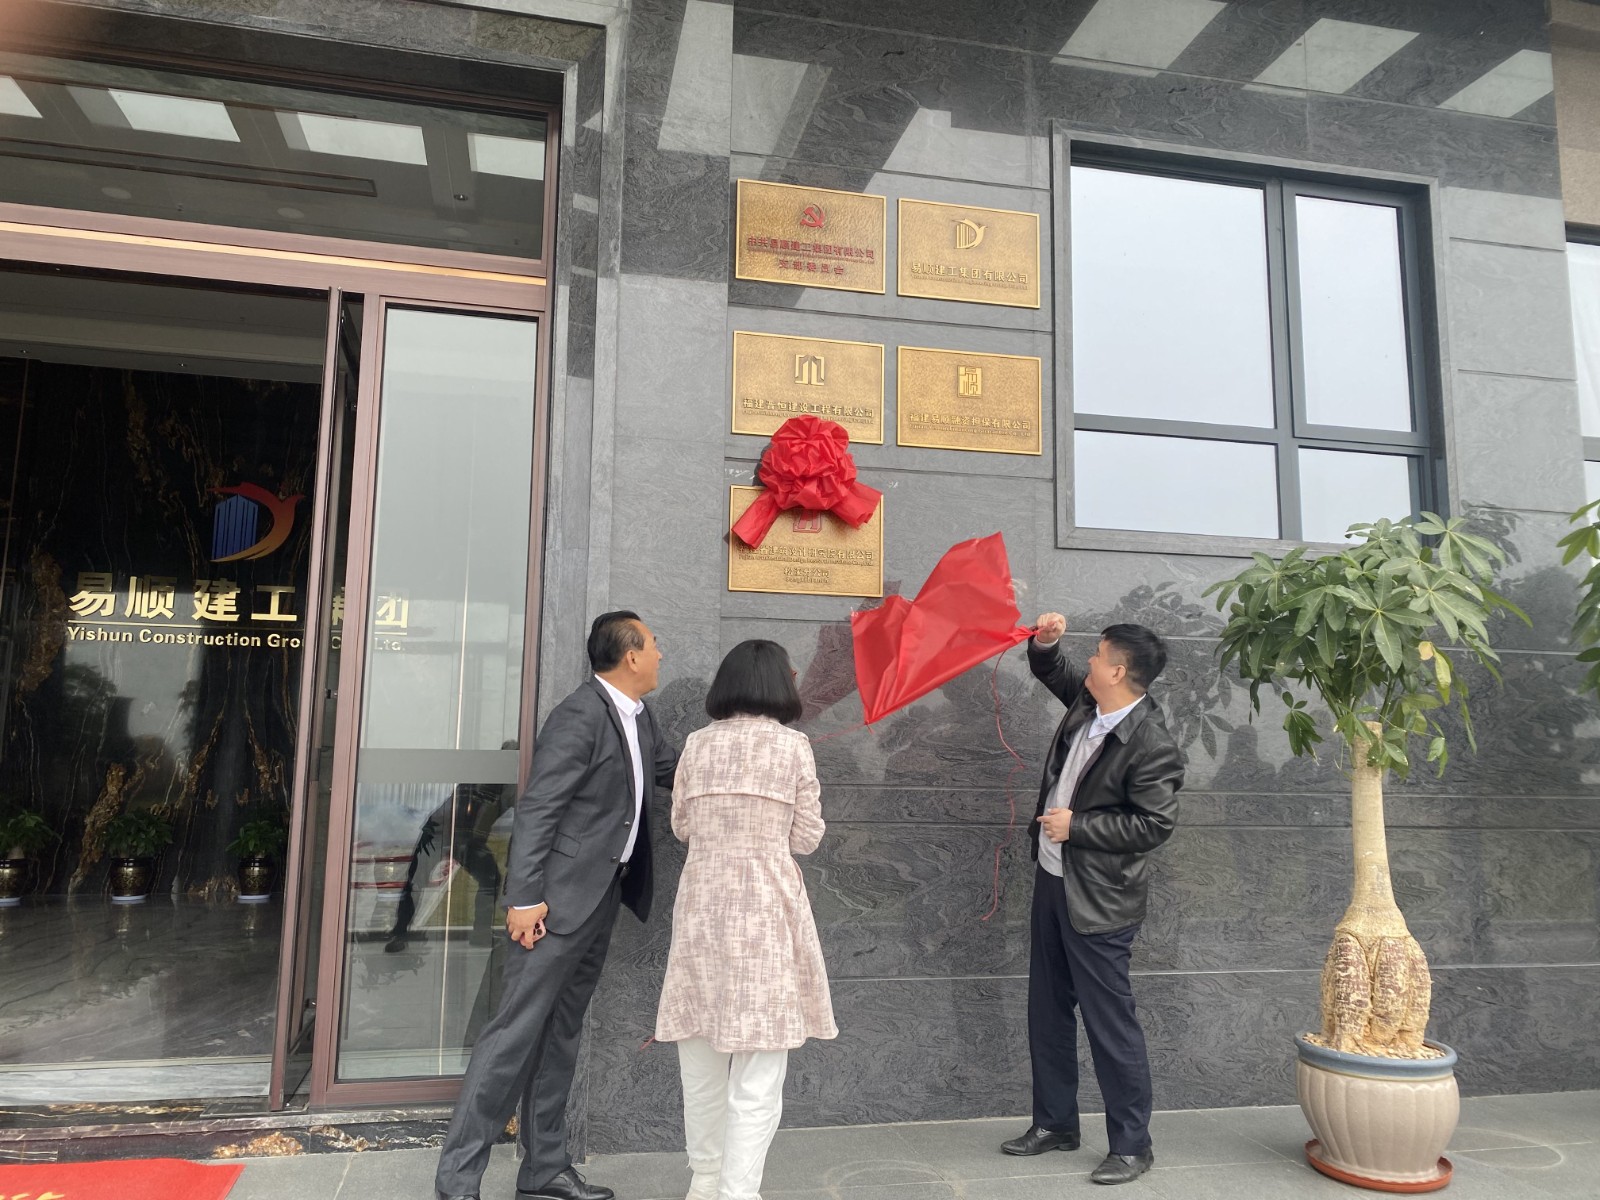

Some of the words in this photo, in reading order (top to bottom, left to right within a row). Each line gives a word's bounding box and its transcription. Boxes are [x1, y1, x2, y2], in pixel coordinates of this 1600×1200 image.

[911, 262, 1028, 284] 易顺建工集团有限公司
[909, 413, 1030, 430] 福建易顺融资担保有限公司
[67, 627, 133, 642] Yishun
[139, 629, 261, 647] Construction
[267, 633, 305, 648] Gro
